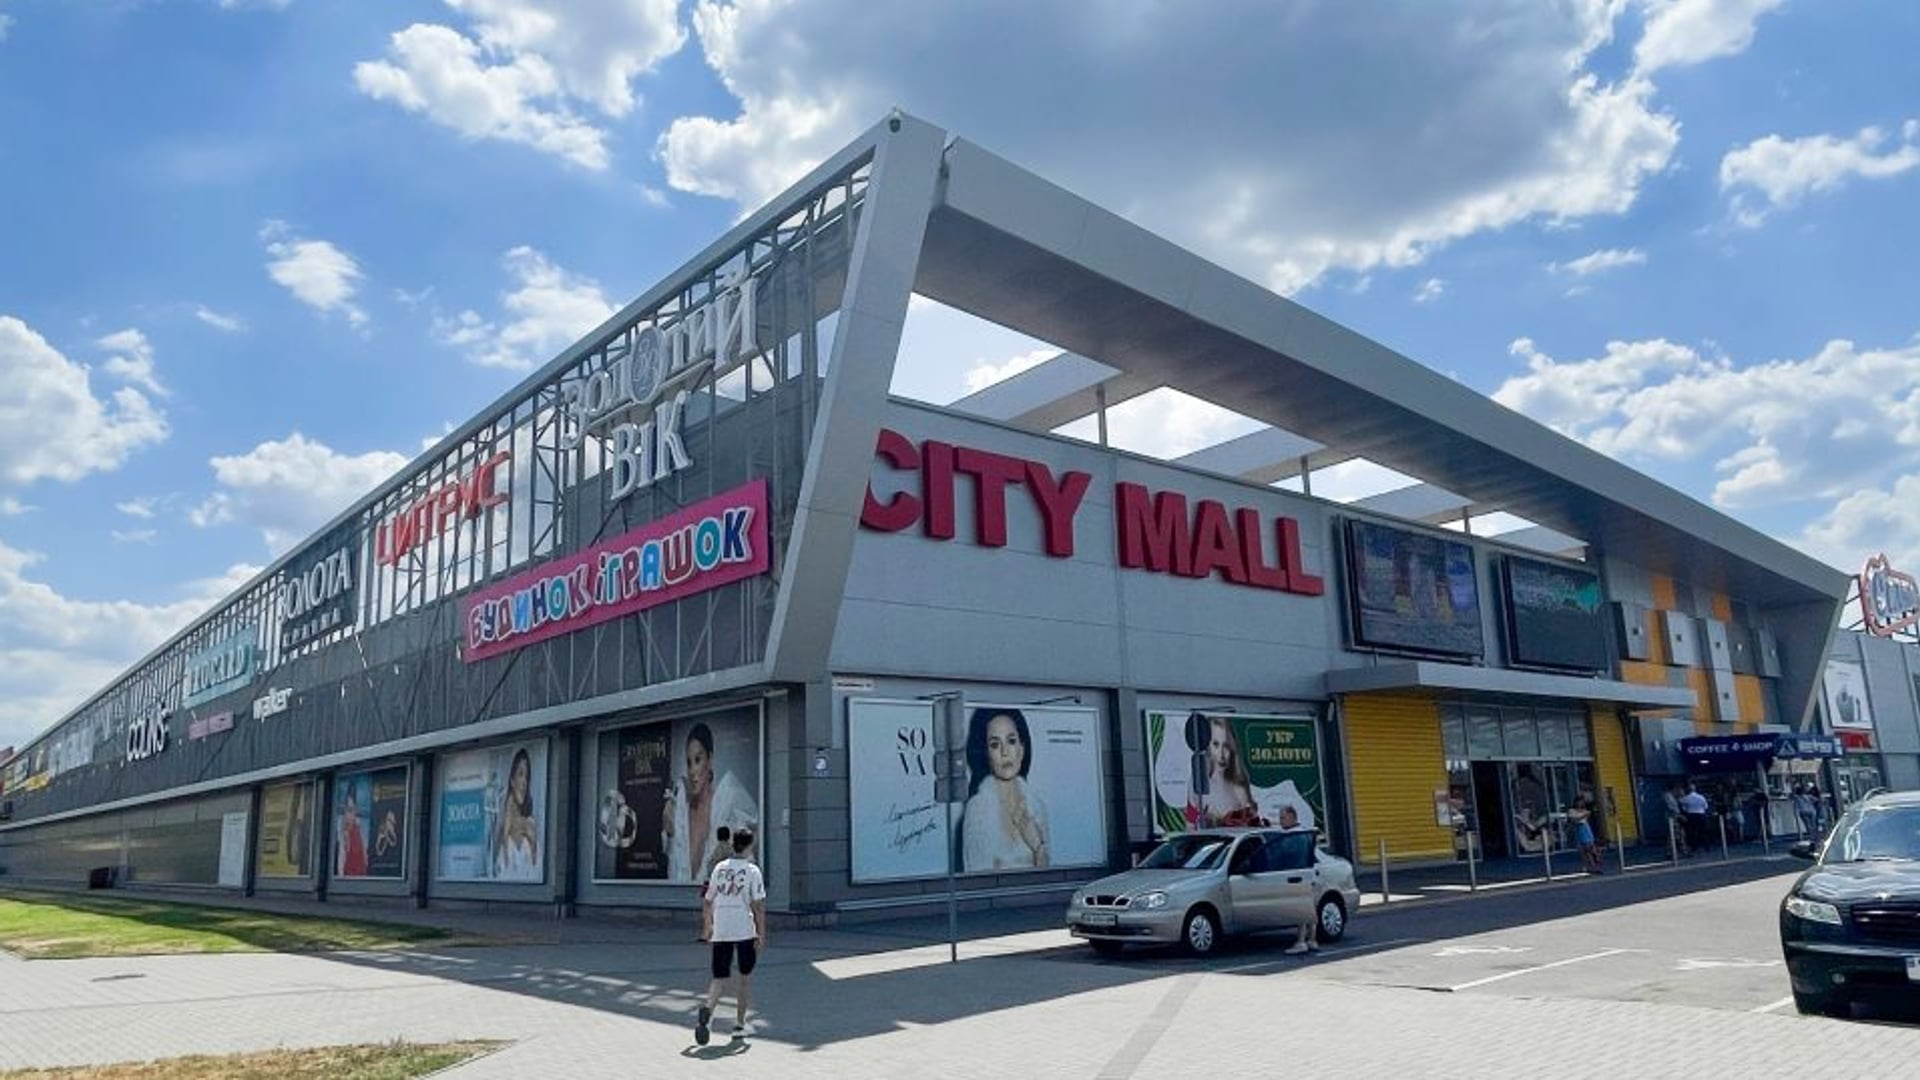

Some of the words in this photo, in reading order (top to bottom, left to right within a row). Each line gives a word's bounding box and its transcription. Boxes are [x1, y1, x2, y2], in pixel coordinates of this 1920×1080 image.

[610, 389, 694, 500] ВІК
[860, 428, 1091, 558] CITY
[1116, 481, 1325, 596] MALL
[469, 563, 592, 649] БУДИНОК
[897, 726, 926, 751] SO
[1251, 747, 1313, 761] ЗОЛОТО
[1687, 743, 1729, 755] COFFEE
[1743, 741, 1774, 752] SHOP
